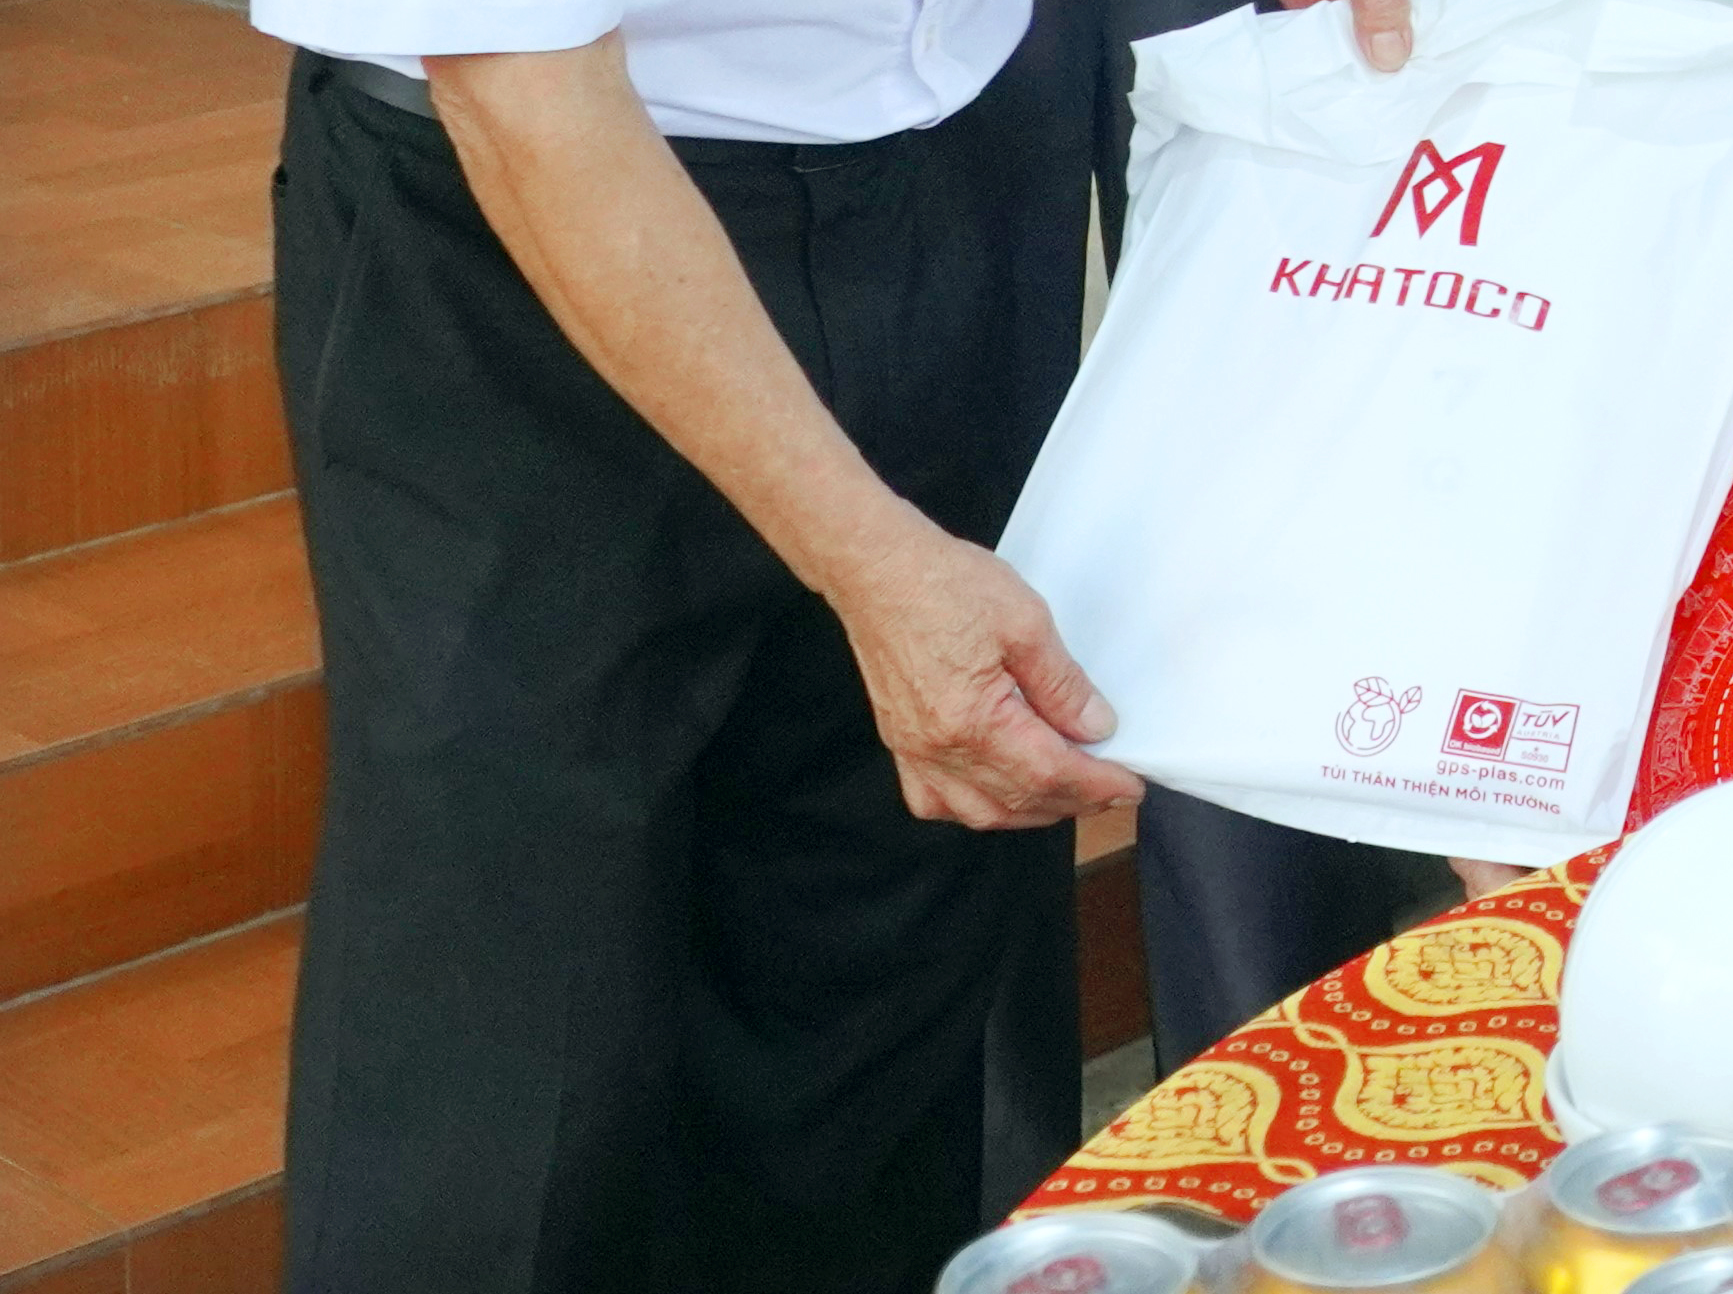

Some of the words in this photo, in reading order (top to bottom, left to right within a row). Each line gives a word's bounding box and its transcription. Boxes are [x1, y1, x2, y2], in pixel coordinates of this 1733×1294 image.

[1269, 257, 1552, 332] KHATOCO
[1353, 770, 1396, 789] THÂN
[1402, 778, 1450, 798] THIỆN
[1455, 786, 1487, 803] MÔI
[1494, 791, 1562, 815] TRƯỜNG
[1436, 758, 1565, 791] gps-plas.com
